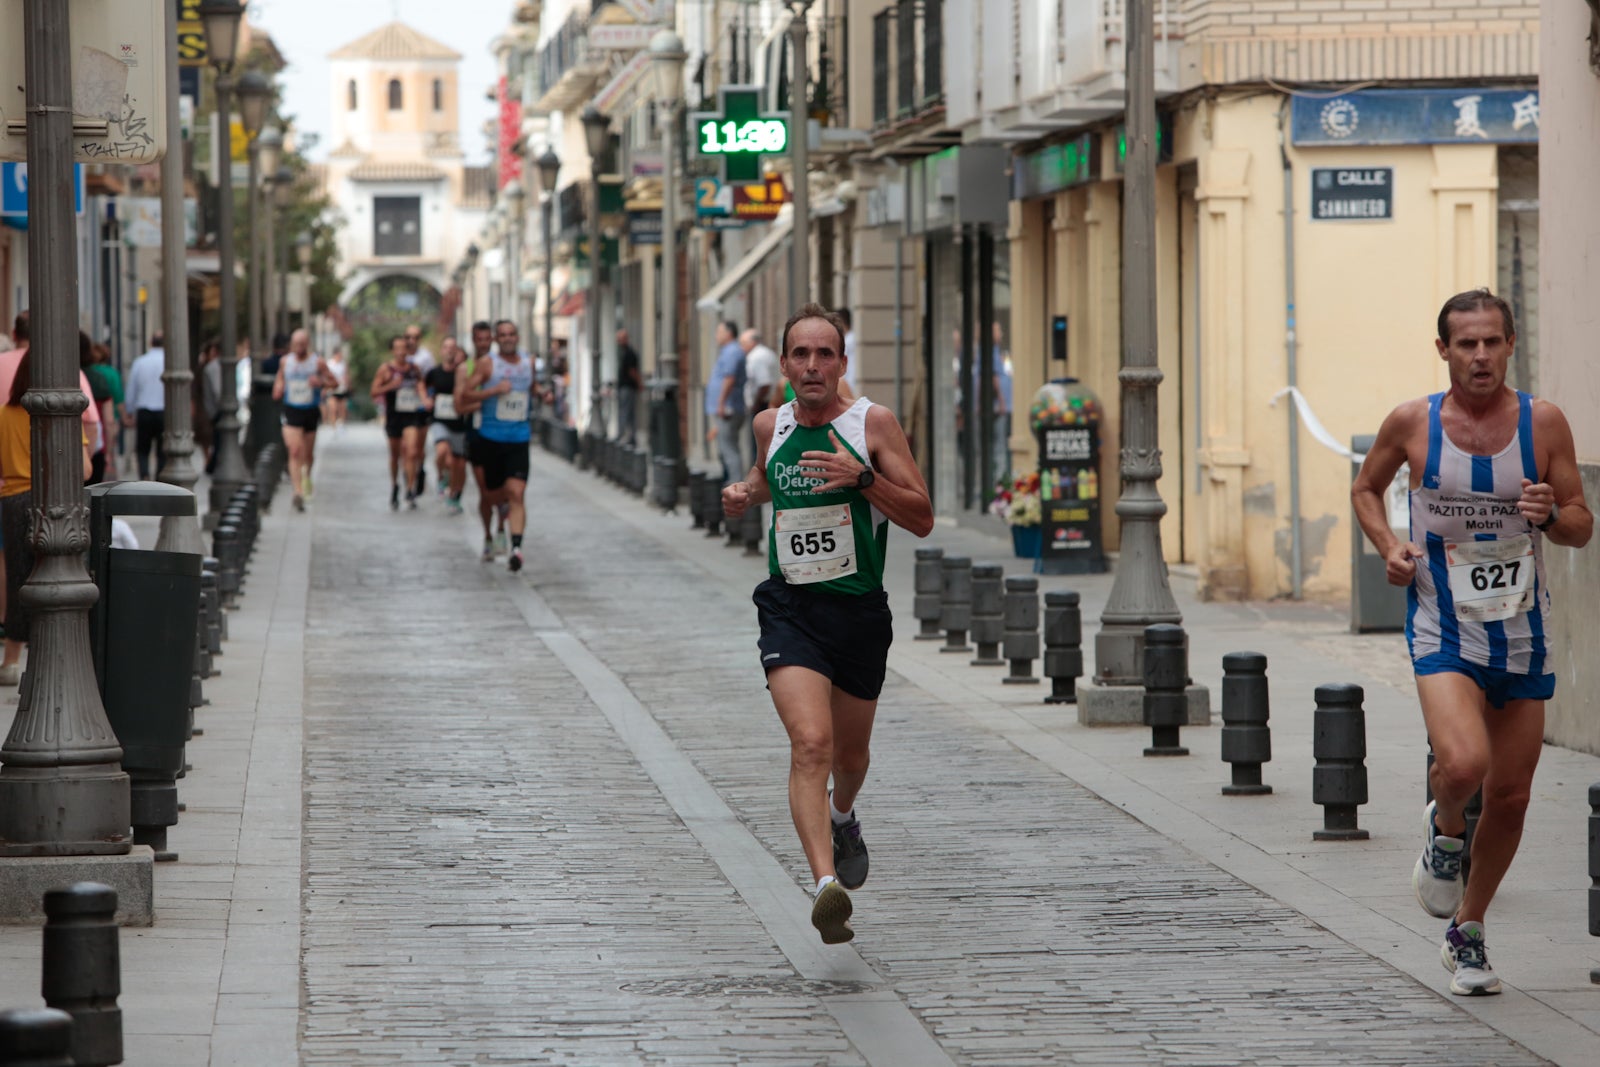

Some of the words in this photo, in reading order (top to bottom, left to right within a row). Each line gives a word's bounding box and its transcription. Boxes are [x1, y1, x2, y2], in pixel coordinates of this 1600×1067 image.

[1337, 171, 1386, 185] CALLE
[1429, 504, 1475, 517] PAZITO
[1479, 507, 1487, 516] a
[1466, 520, 1502, 529] Motril
[790, 531, 836, 556] 655
[1471, 561, 1521, 591] 627
